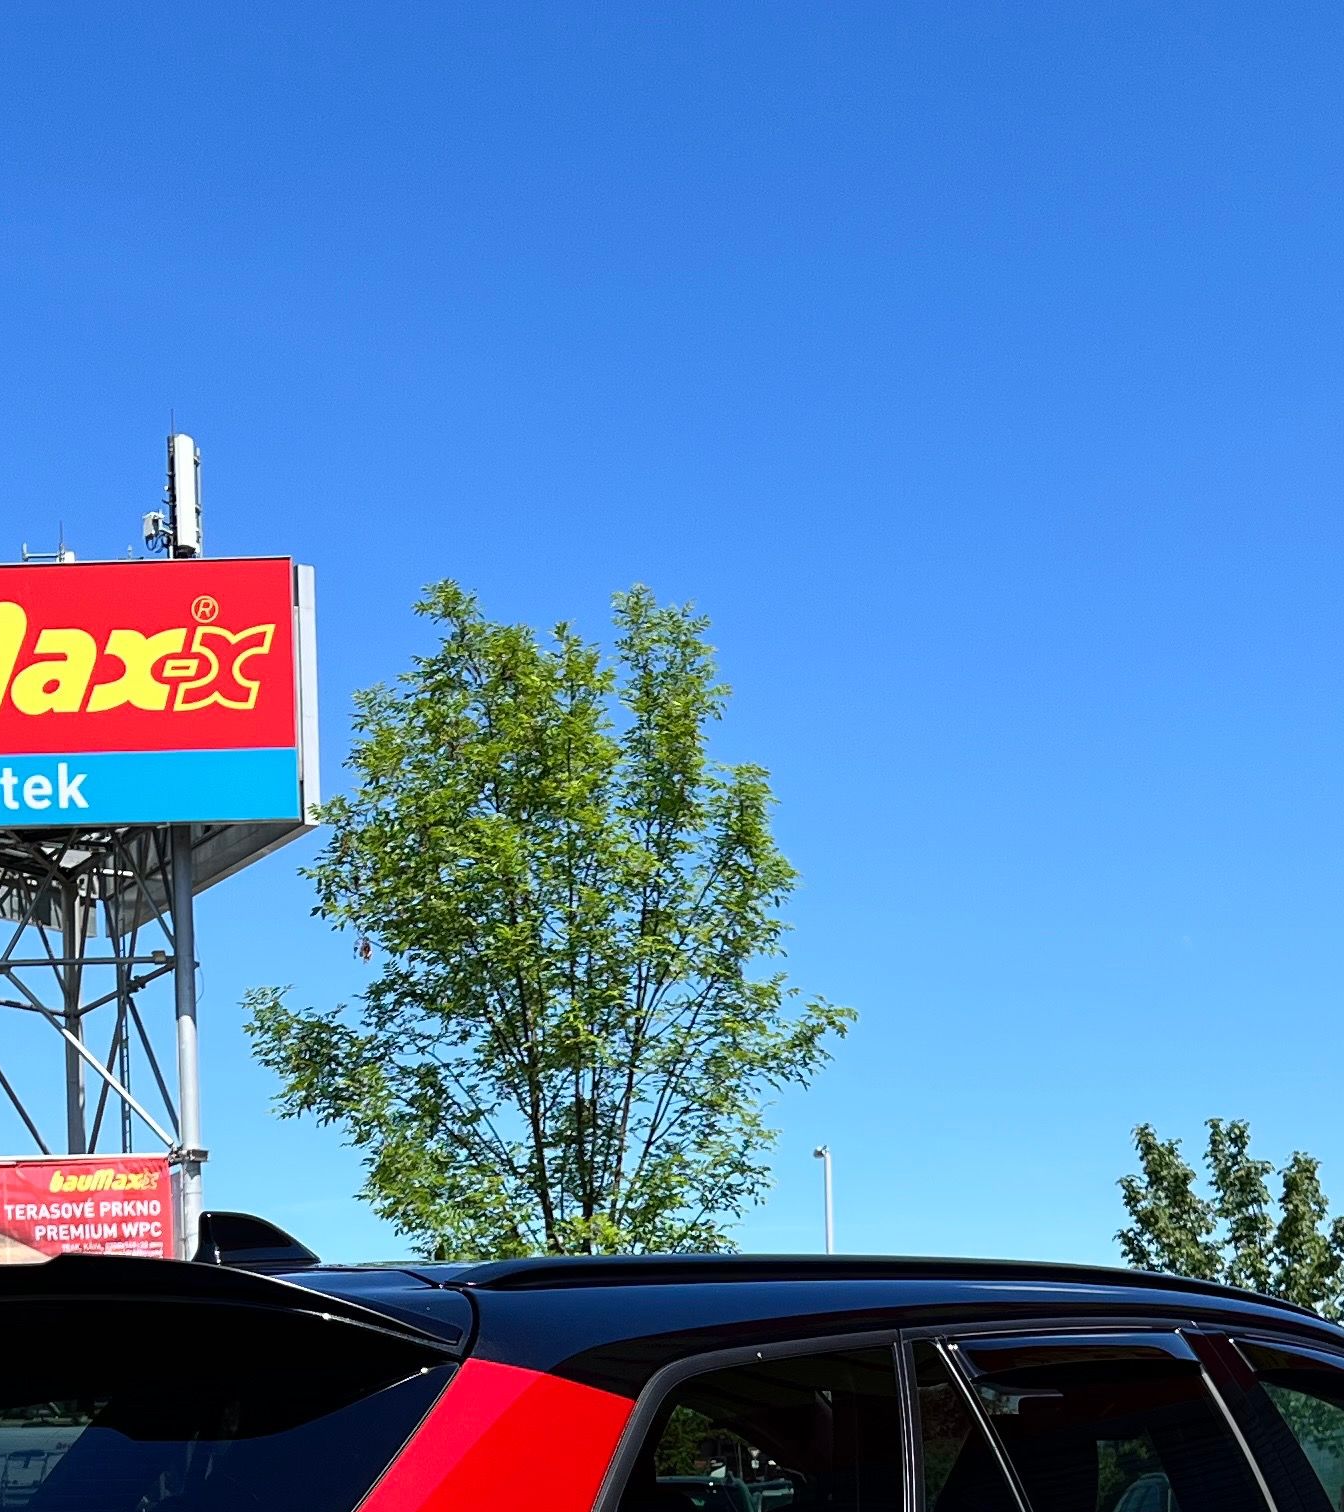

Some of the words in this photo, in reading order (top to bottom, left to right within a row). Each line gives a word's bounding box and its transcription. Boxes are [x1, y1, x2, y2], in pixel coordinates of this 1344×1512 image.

[4, 1198, 95, 1221] TERASOVÉ
[99, 1199, 161, 1218] PRKNO
[34, 1223, 118, 1241] PREMIUM
[121, 1221, 163, 1239] WPC
